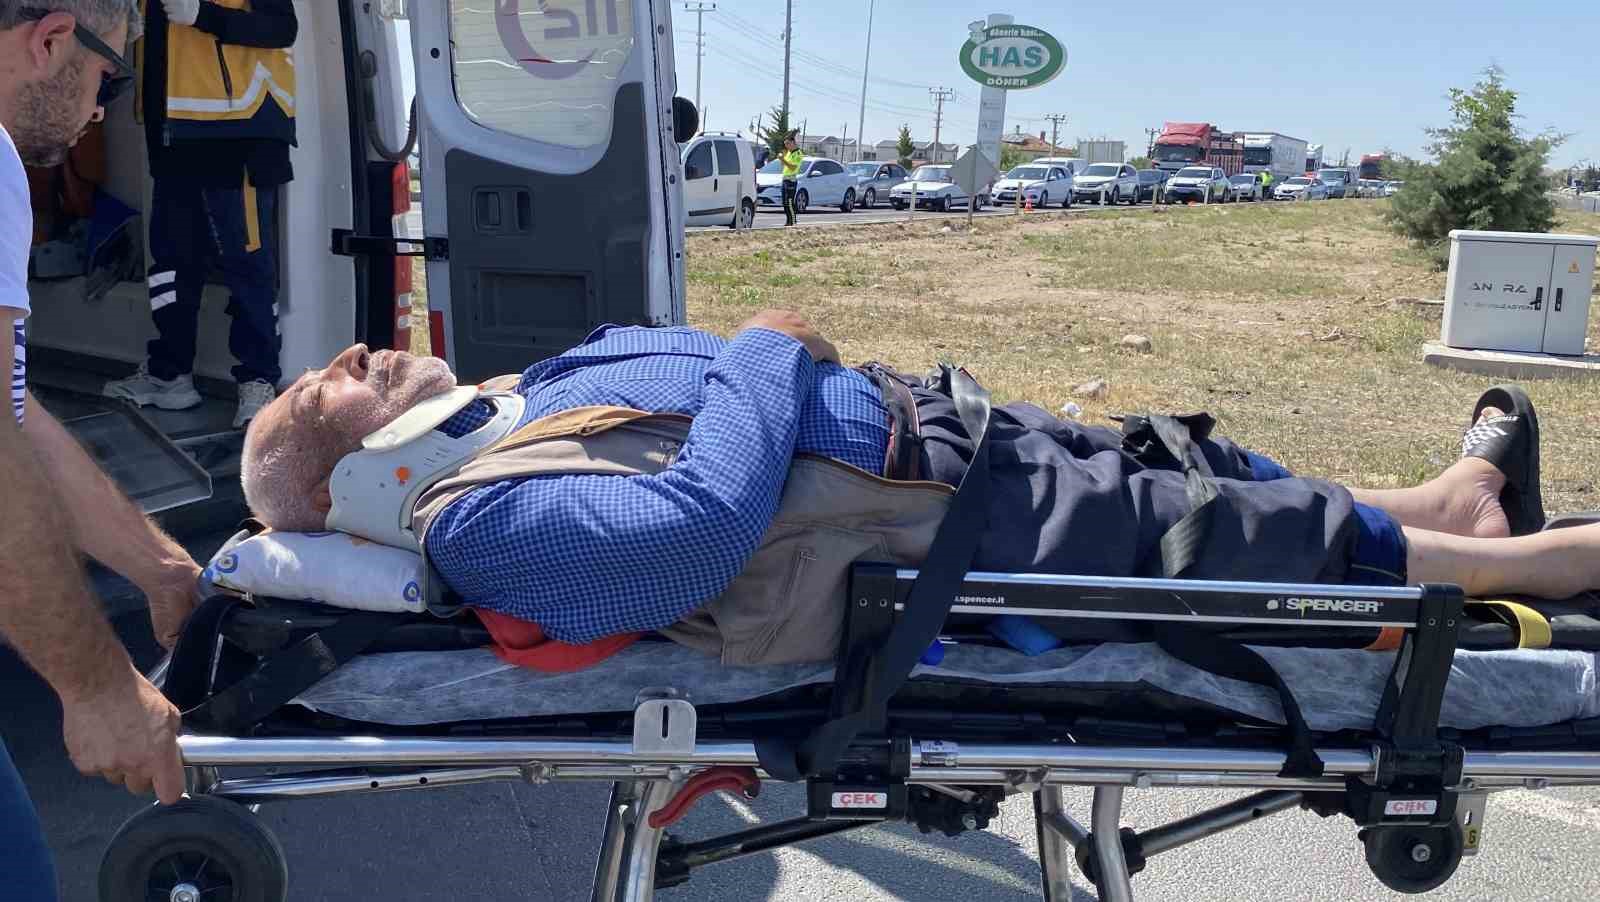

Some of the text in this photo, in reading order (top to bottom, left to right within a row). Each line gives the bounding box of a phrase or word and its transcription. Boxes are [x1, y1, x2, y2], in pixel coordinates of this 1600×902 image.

[979, 46, 1043, 68] HAS
[986, 77, 1028, 87] DÖNER
[1286, 597, 1379, 614] SPENCER
[839, 793, 878, 806] ÇEK
